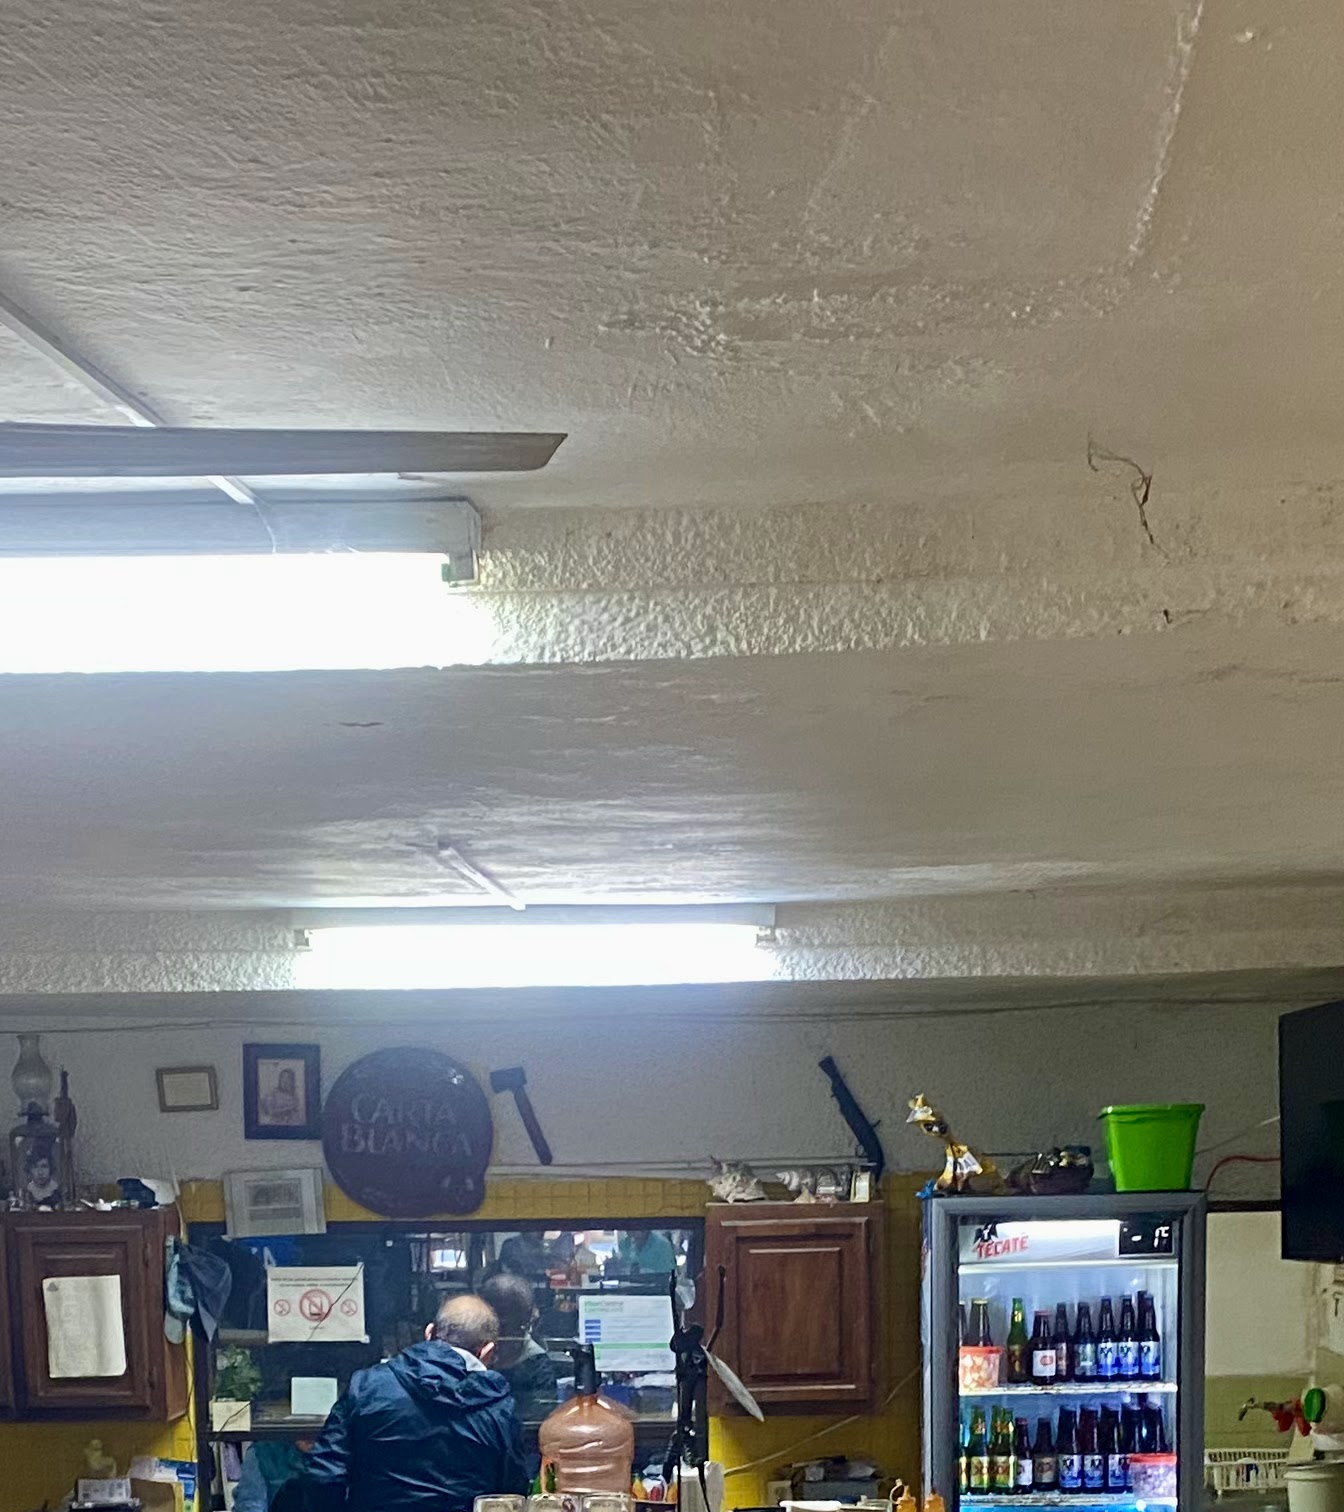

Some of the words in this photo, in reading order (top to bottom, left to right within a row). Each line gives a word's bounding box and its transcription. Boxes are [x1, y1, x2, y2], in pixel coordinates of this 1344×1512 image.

[351, 1093, 456, 1124] CARTA
[341, 1123, 472, 1156] BLANCA
[973, 1234, 1029, 1259] TECATE
